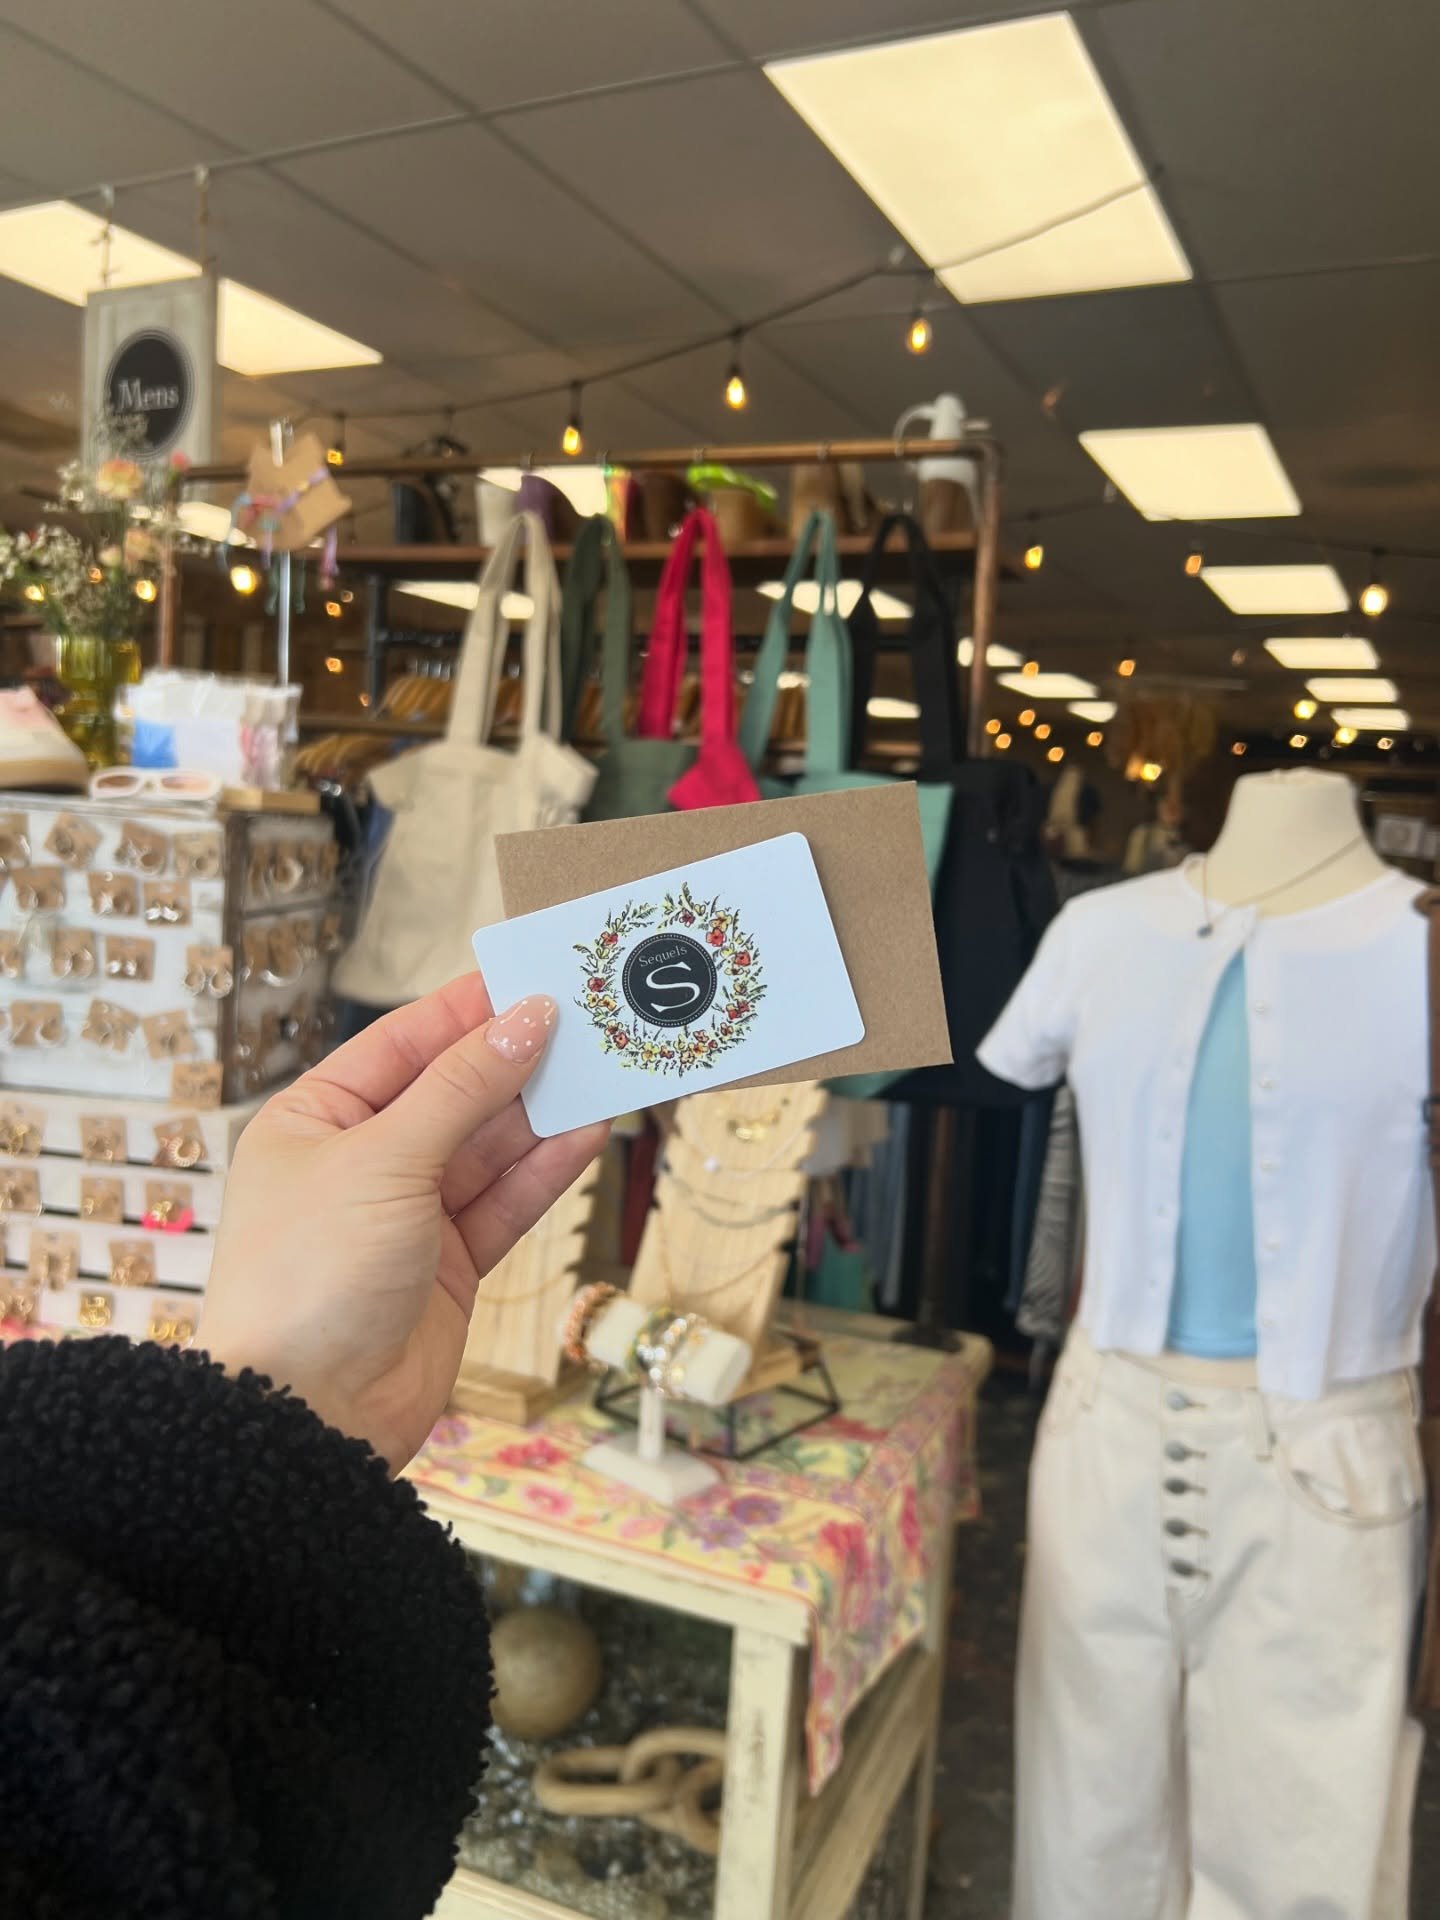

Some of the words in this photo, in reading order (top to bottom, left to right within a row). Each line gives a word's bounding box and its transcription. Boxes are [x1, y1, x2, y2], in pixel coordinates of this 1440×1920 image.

[118, 377, 179, 411] Mens
[638, 945, 687, 967] Sequels
[646, 961, 700, 1013] S
